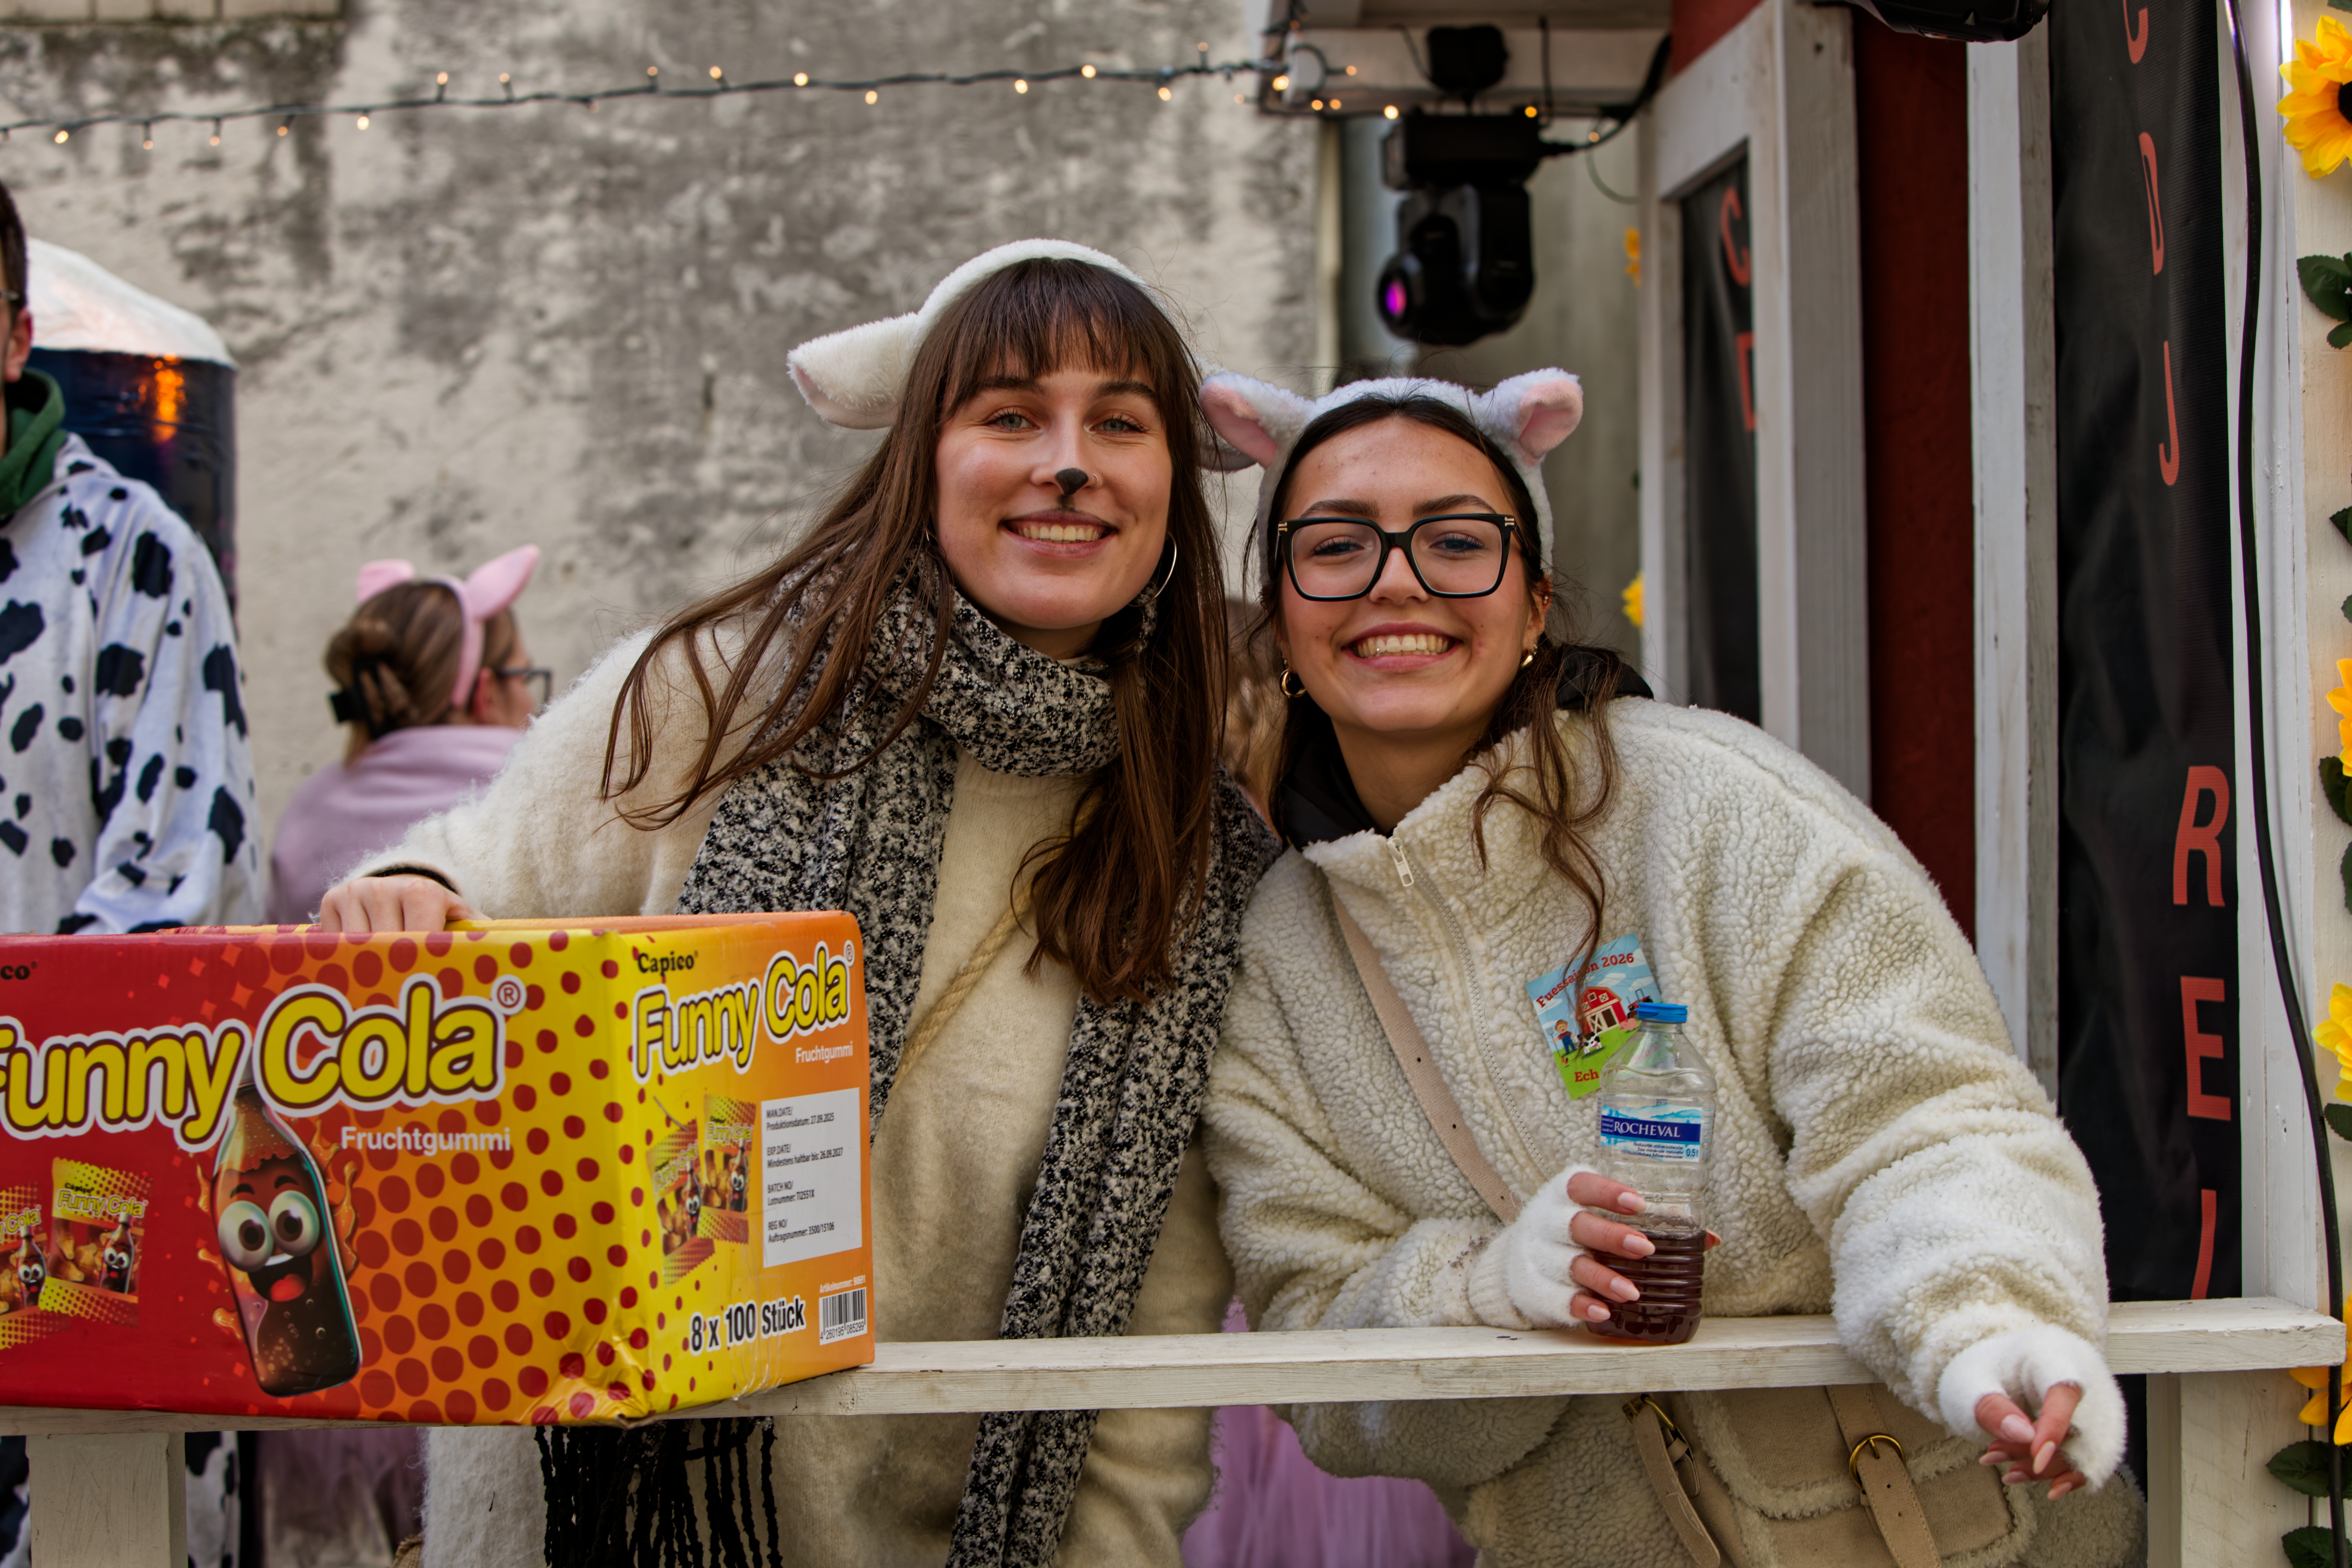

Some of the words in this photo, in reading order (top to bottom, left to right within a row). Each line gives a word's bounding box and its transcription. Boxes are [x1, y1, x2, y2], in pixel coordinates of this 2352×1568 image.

[1601, 953, 1634, 968] 2026
[637, 983, 759, 1078] Funny
[796, 1041, 853, 1064] Fruchtgummi
[767, 1118, 810, 1131] Produktionsdatum:
[811, 1112, 834, 1124] 27.09.2025
[1614, 1121, 1681, 1137] ROCHEVAL
[341, 1127, 511, 1156] Fruchtgummi
[767, 1157, 794, 1168] Mindestens
[795, 1154, 810, 1164] haltbar
[811, 1152, 819, 1161] bis:
[768, 1182, 783, 1193] BATCH
[58, 1189, 105, 1216] Funny
[768, 1194, 796, 1206] Lotnummer:
[768, 1220, 777, 1230] REG
[768, 1229, 808, 1243] Auftragsnummer:
[808, 1221, 835, 1235] 3500/15106
[819, 1279, 853, 1294] Artikelnummer:
[691, 1315, 702, 1352] 8
[708, 1318, 720, 1348] x
[725, 1303, 757, 1343] 100
[762, 1298, 805, 1335] Stück
[820, 1331, 824, 1341] 4
[826, 1327, 844, 1340] 260195
[846, 1321, 864, 1334] 085299
